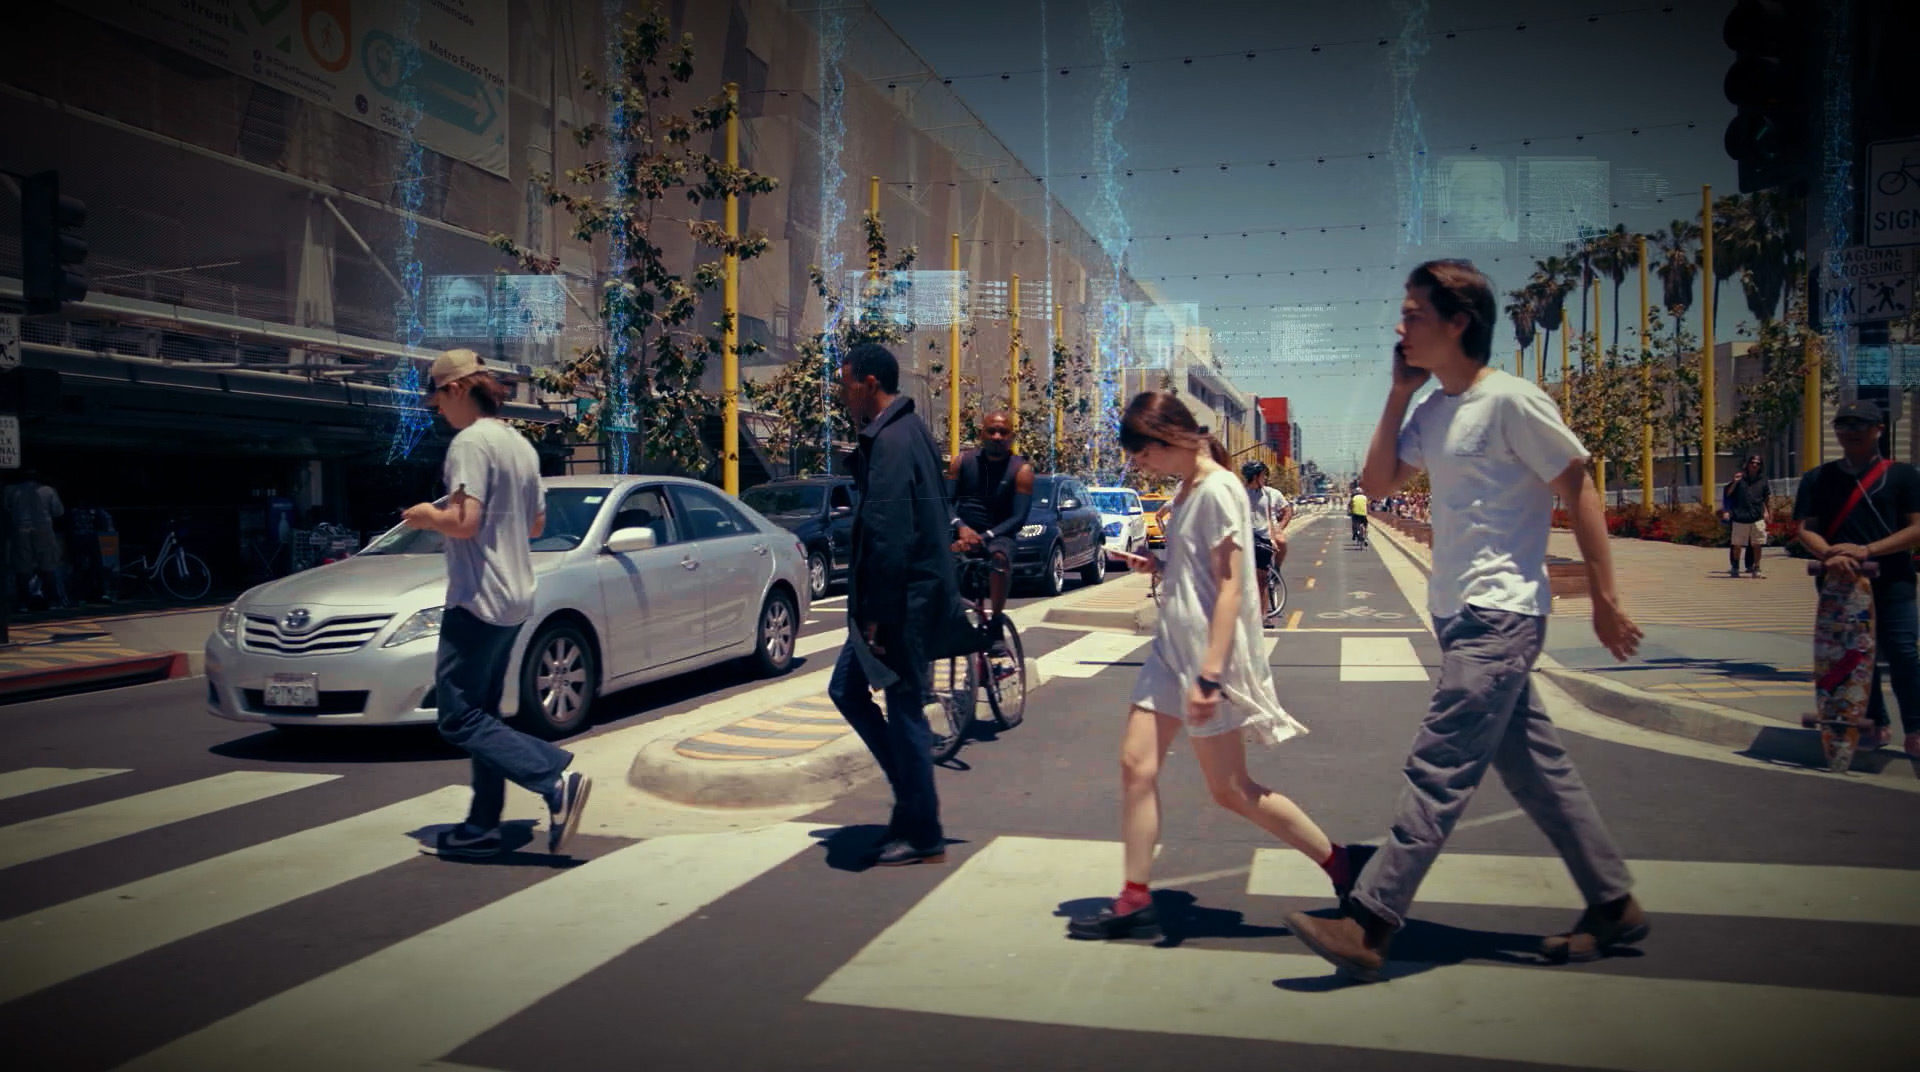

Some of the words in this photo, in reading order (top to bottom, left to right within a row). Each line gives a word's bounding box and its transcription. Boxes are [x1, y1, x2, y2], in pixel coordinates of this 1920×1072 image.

[429, 40, 458, 63] Metro
[460, 55, 482, 74] Expo
[484, 67, 505, 87] Train
[1831, 248, 1903, 264] AGONAL
